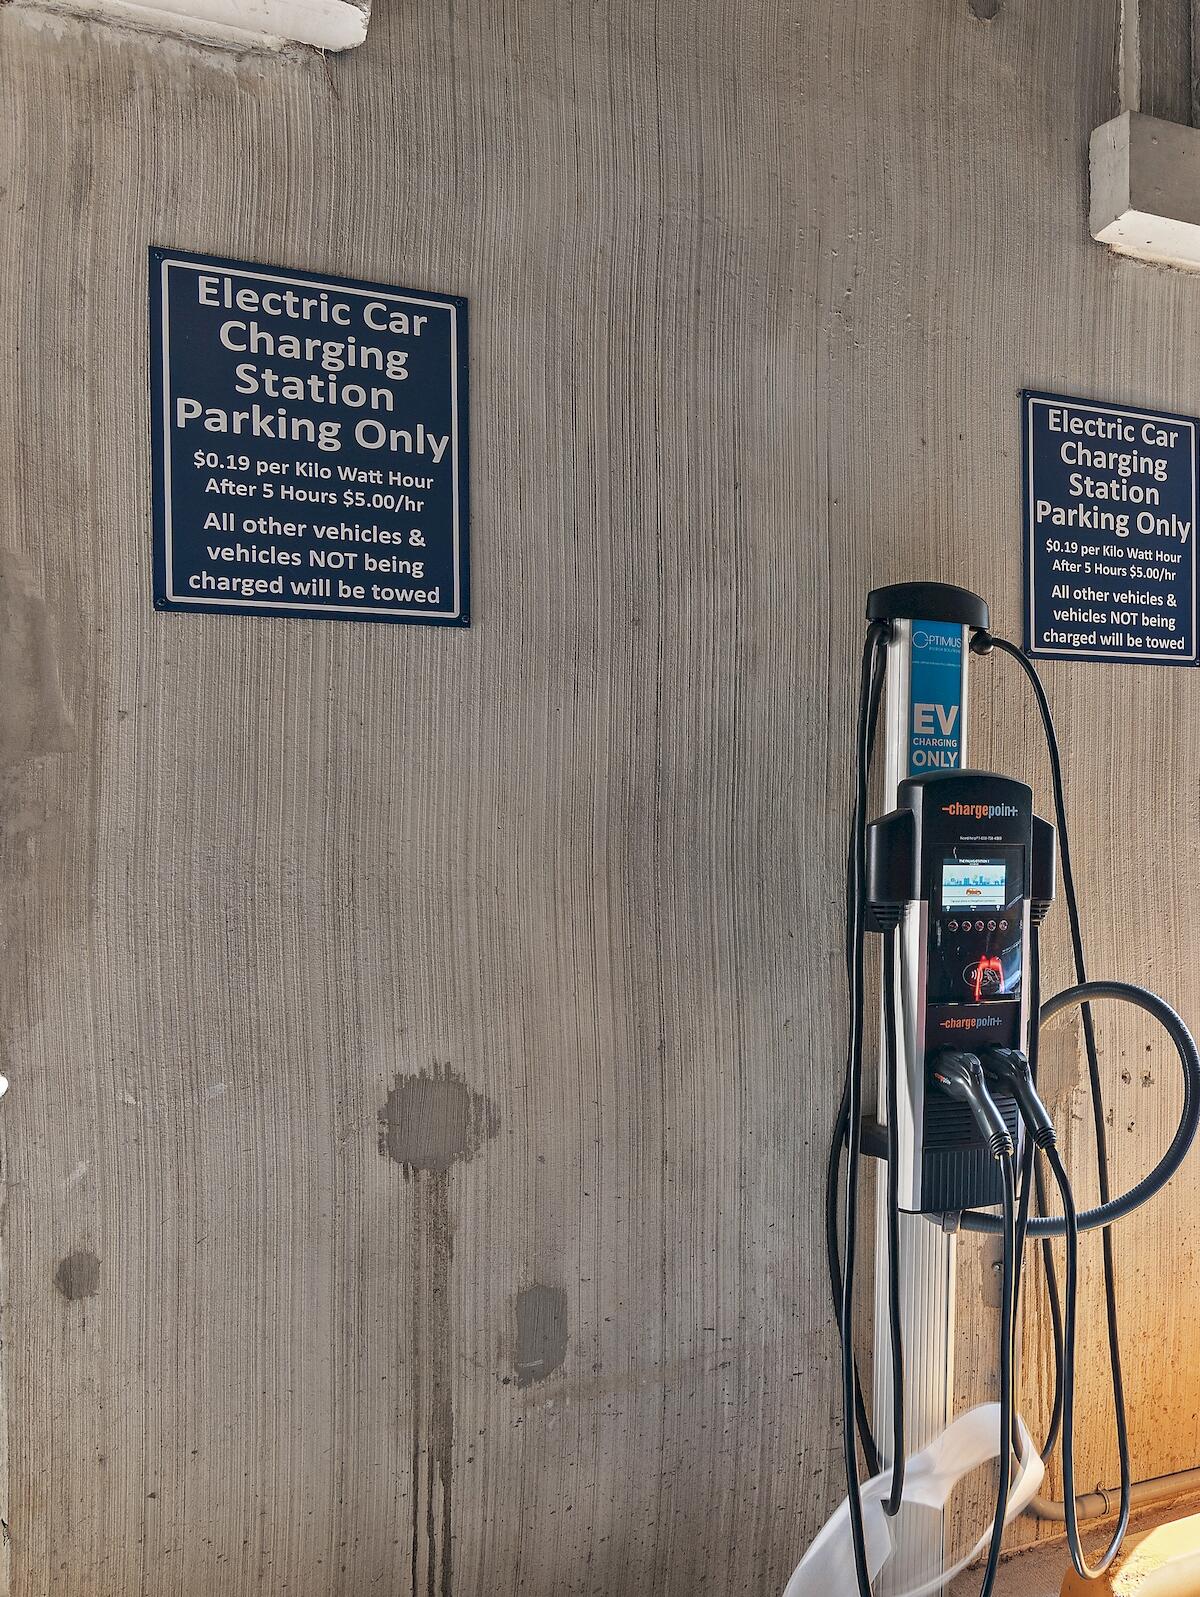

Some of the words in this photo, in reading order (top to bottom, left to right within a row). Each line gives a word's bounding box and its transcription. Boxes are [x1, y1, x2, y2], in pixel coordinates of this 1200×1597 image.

[199, 276, 350, 325] Electric
[364, 302, 427, 336] Car
[220, 321, 408, 380] Charging
[236, 364, 393, 411] Station
[177, 398, 341, 451] Parking
[355, 420, 449, 463] Only
[1049, 409, 1134, 442] Electric
[1142, 423, 1178, 448] Car
[194, 449, 250, 471] $0.19
[257, 461, 289, 475] per
[296, 462, 331, 478] Kilo
[337, 466, 383, 484] Watt
[389, 471, 433, 489] Hour
[1061, 442, 1167, 481] Charging
[205, 478, 256, 496] After
[263, 483, 274, 498] 5
[281, 485, 337, 504] Hours
[343, 489, 424, 512] $5.00/hr
[1069, 473, 1159, 505] Station
[204, 513, 234, 531] All
[243, 517, 307, 537] other
[313, 523, 402, 544] vehicles
[409, 529, 426, 547] &
[1037, 500, 1129, 537] Parking
[1137, 512, 1191, 543] Only
[207, 544, 301, 565] vehicles
[310, 550, 357, 569] NOT
[365, 553, 424, 578] being
[1046, 538, 1078, 553] $0.19
[1081, 546, 1100, 557] per
[1103, 545, 1124, 557] Kilo
[1127, 547, 1153, 560] Watt
[1156, 550, 1182, 563] Hour
[189, 571, 282, 596] charged
[290, 579, 330, 596] will
[339, 580, 365, 599] be
[372, 585, 439, 603] towed
[1053, 559, 1082, 572] After
[1085, 562, 1091, 573] 5
[1095, 563, 1127, 576] Hours
[1130, 565, 1176, 582] $5.00/hr
[1052, 585, 1069, 599] All
[1073, 587, 1109, 601] other
[1113, 590, 1163, 606] vehicles
[1167, 594, 1177, 607] &
[1053, 608, 1106, 623] vehicles
[1111, 611, 1138, 625] NOT
[1142, 613, 1175, 631] being
[1044, 628, 1096, 647] charged
[1100, 632, 1122, 646] will
[1127, 633, 1142, 647] be
[1146, 636, 1184, 649] towed
[913, 703, 959, 735] EV
[912, 749, 958, 768] ONLY
[913, 737, 957, 748] CHARGING
